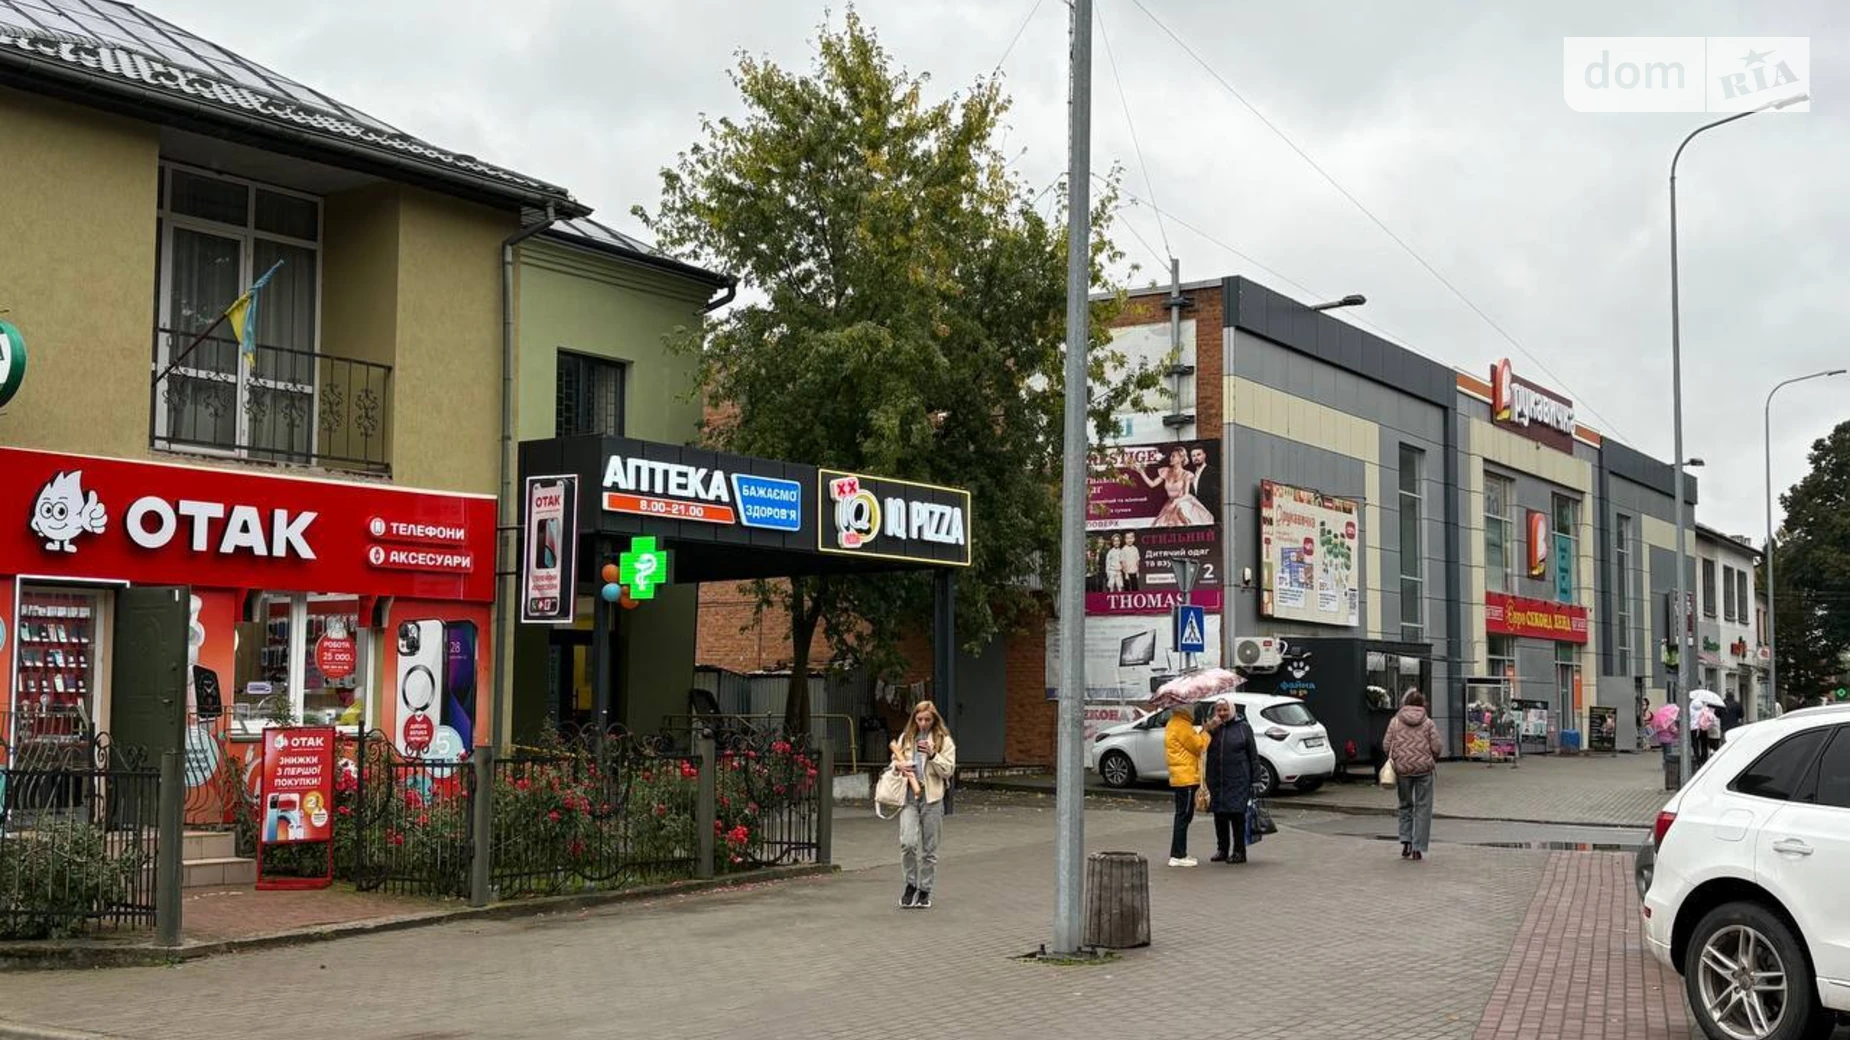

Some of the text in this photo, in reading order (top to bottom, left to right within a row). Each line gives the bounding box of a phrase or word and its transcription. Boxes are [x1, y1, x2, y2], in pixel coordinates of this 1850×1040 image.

[602, 455, 730, 502] АПТЕКА
[535, 495, 561, 509] ОТАК
[742, 485, 798, 502] БАЖАЄМО
[639, 499, 705, 517] 8.00-21.00
[745, 504, 797, 521] ЗДОРОВ'Я
[126, 495, 319, 560] ОТАК
[884, 497, 965, 545] IQ PIZZA
[390, 522, 466, 540] ТЕЛЕФОНИ
[390, 550, 471, 568] АКСЕСУАРИ
[1202, 563, 1215, 579] 2
[291, 736, 325, 747] ОТАК
[279, 755, 319, 765] ЗНИЖКИ
[276, 765, 322, 776] З ПЕРШОЇ
[274, 776, 322, 787] ПОКУПКИ!
